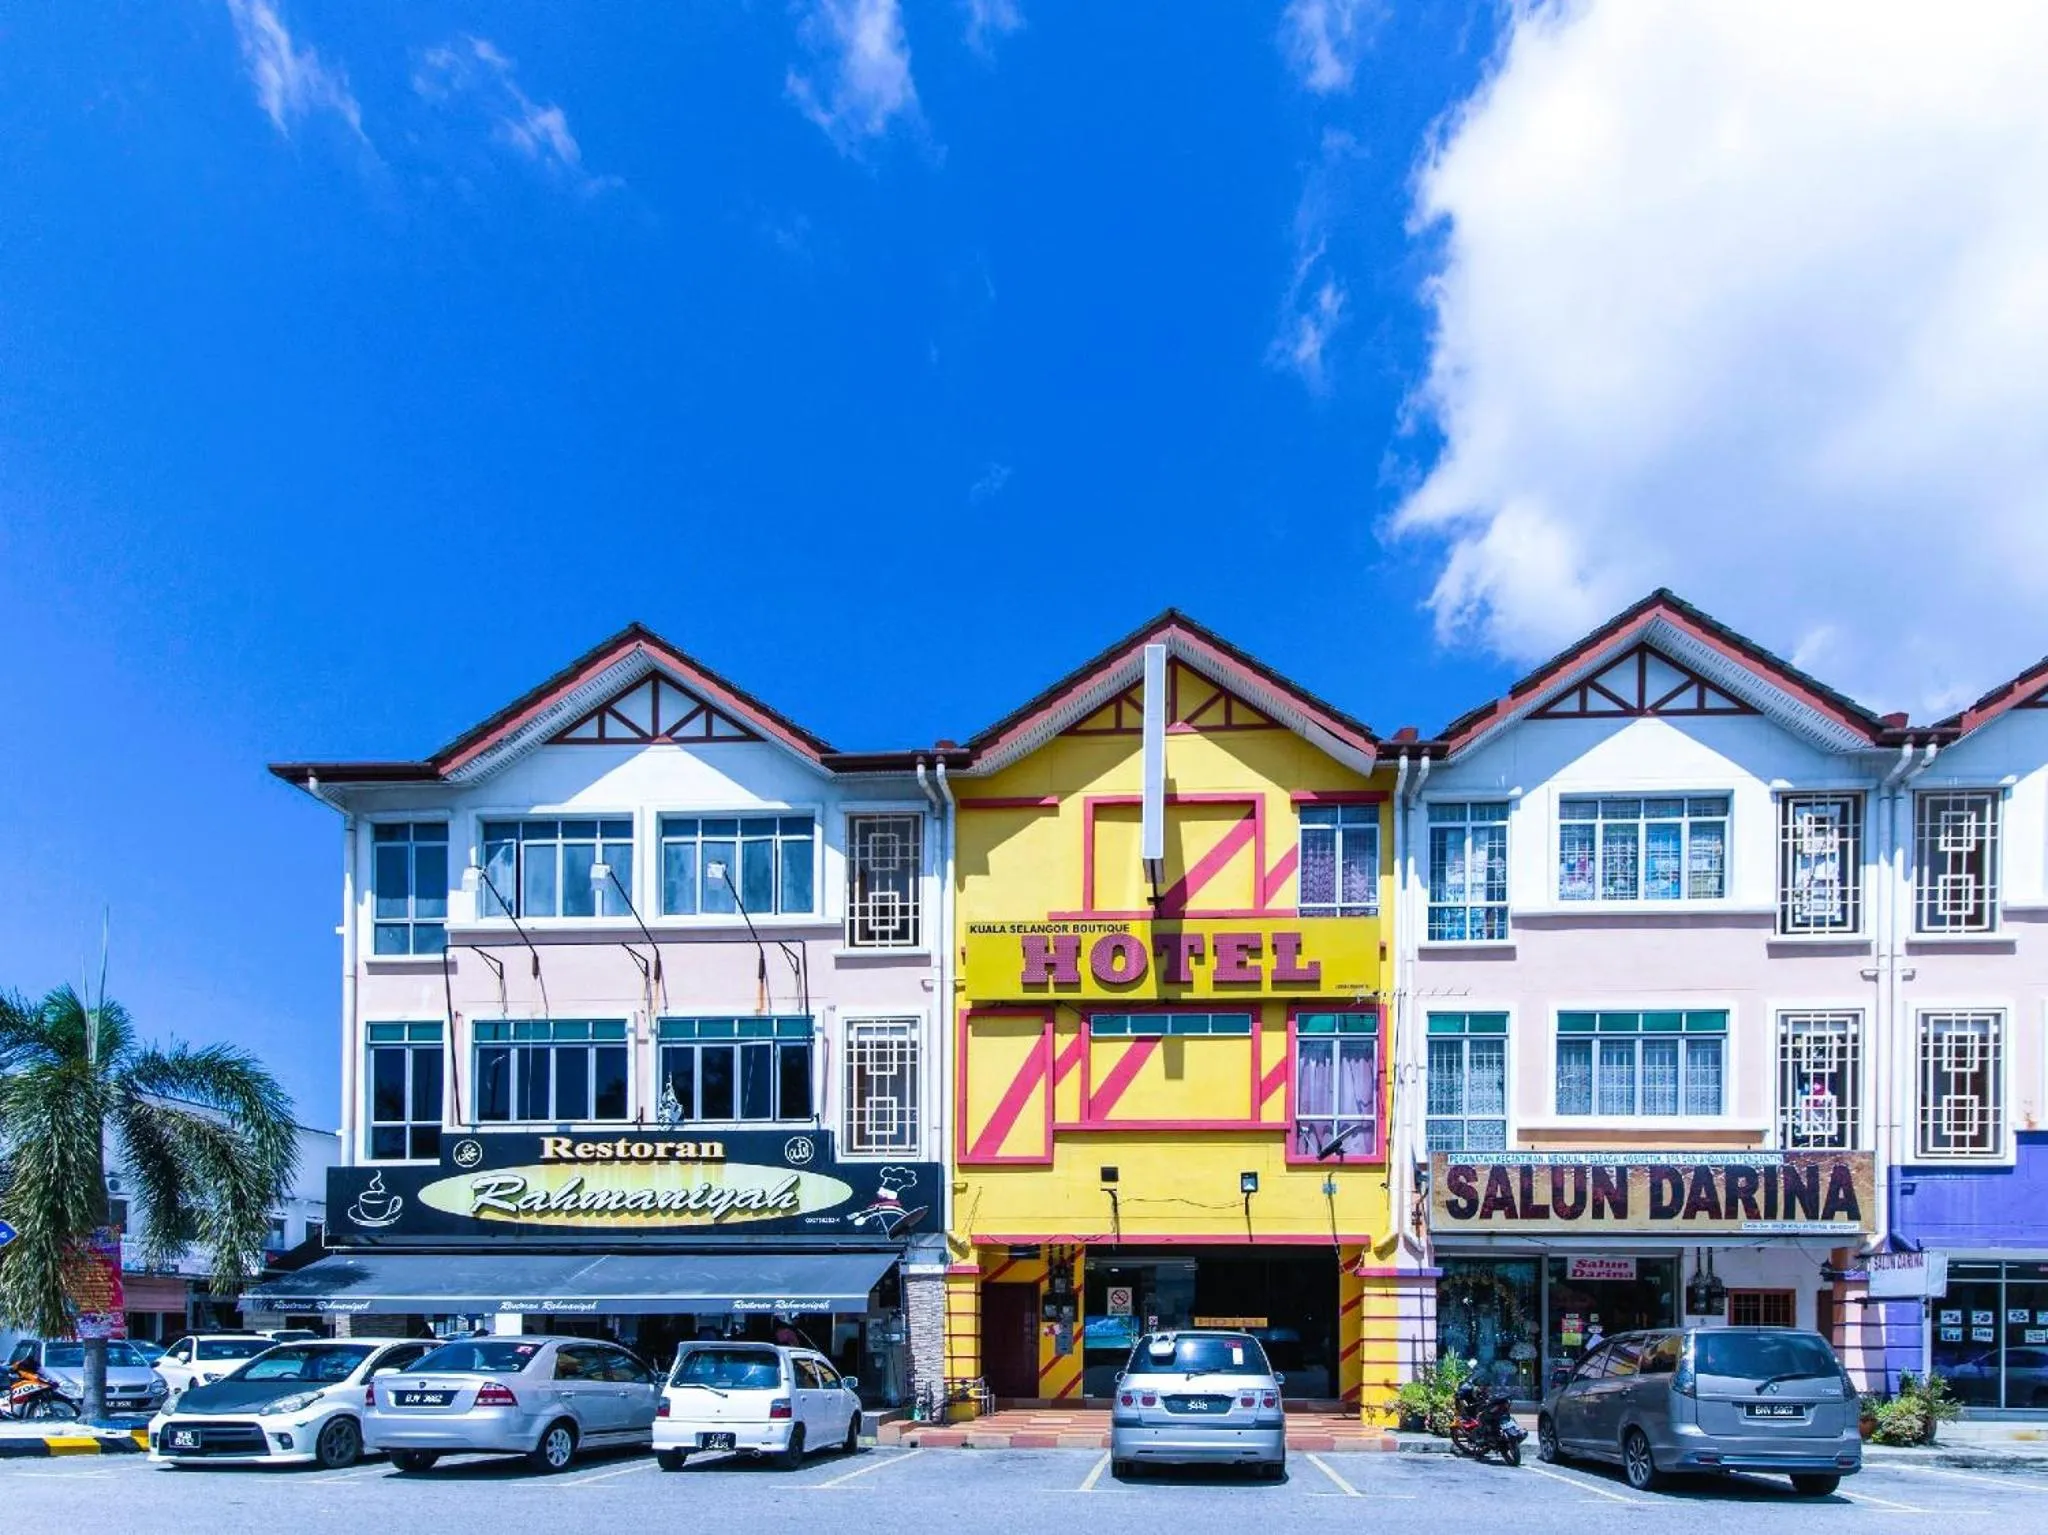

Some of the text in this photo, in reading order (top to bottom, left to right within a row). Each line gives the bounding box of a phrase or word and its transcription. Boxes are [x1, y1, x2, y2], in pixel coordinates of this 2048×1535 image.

[969, 923, 1130, 934] KUALA SELANGOR BOUTIQUE
[1021, 932, 1321, 985] HOTEL
[539, 1136, 726, 1160] Restoran
[470, 1173, 799, 1220] Rahmaniyah
[1446, 1165, 1862, 1220] SALUN DARINA
